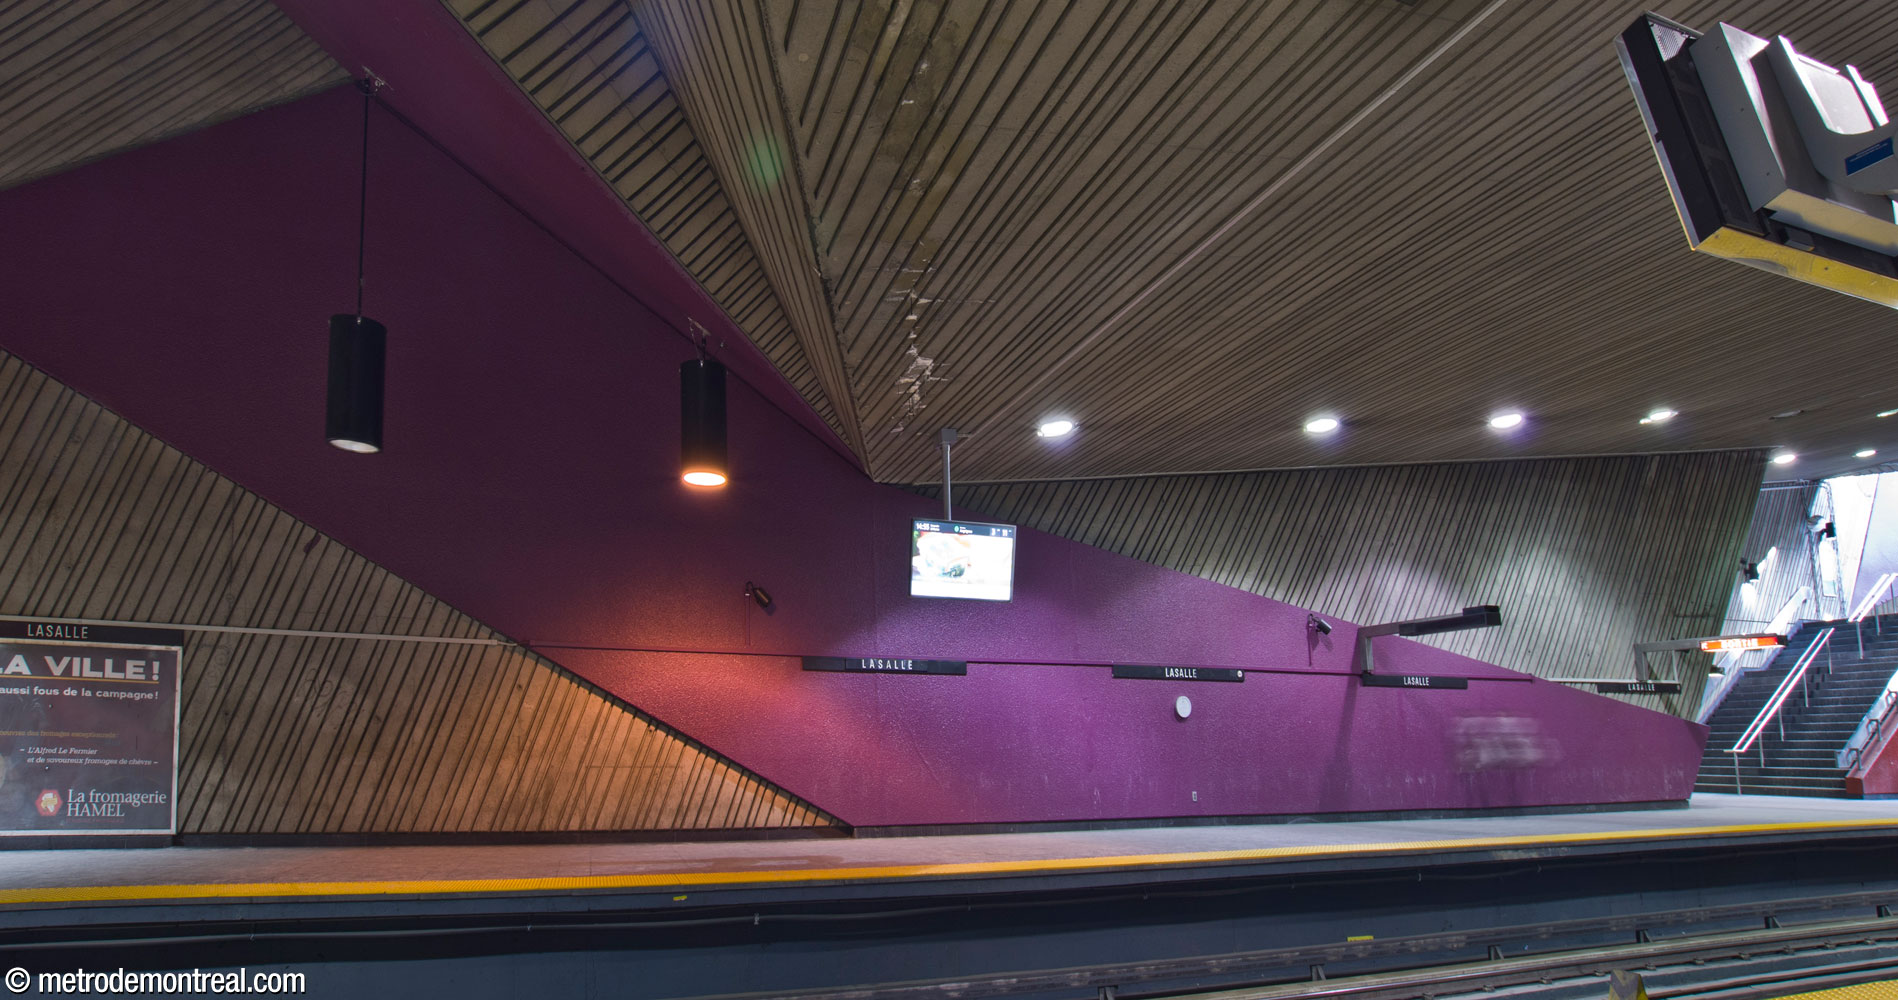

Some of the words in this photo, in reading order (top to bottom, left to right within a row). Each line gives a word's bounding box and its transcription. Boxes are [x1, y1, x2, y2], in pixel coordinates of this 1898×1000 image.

[27, 624, 89, 639] LASALLE
[0, 654, 32, 675] A
[861, 659, 913, 670] LASALLE
[1165, 667, 1198, 679] LASALLE
[1403, 676, 1430, 686] LASALLE
[1627, 683, 1655, 691] LASALLE
[0, 685, 30, 695] aussi
[33, 685, 60, 696] fous
[63, 686, 78, 697] de
[81, 687, 92, 697] la
[69, 747, 98, 755] Fermier
[84, 757, 118, 766] fromages
[67, 788, 86, 803] La
[89, 788, 167, 807] fromagerie
[66, 803, 125, 817] HAMEL
